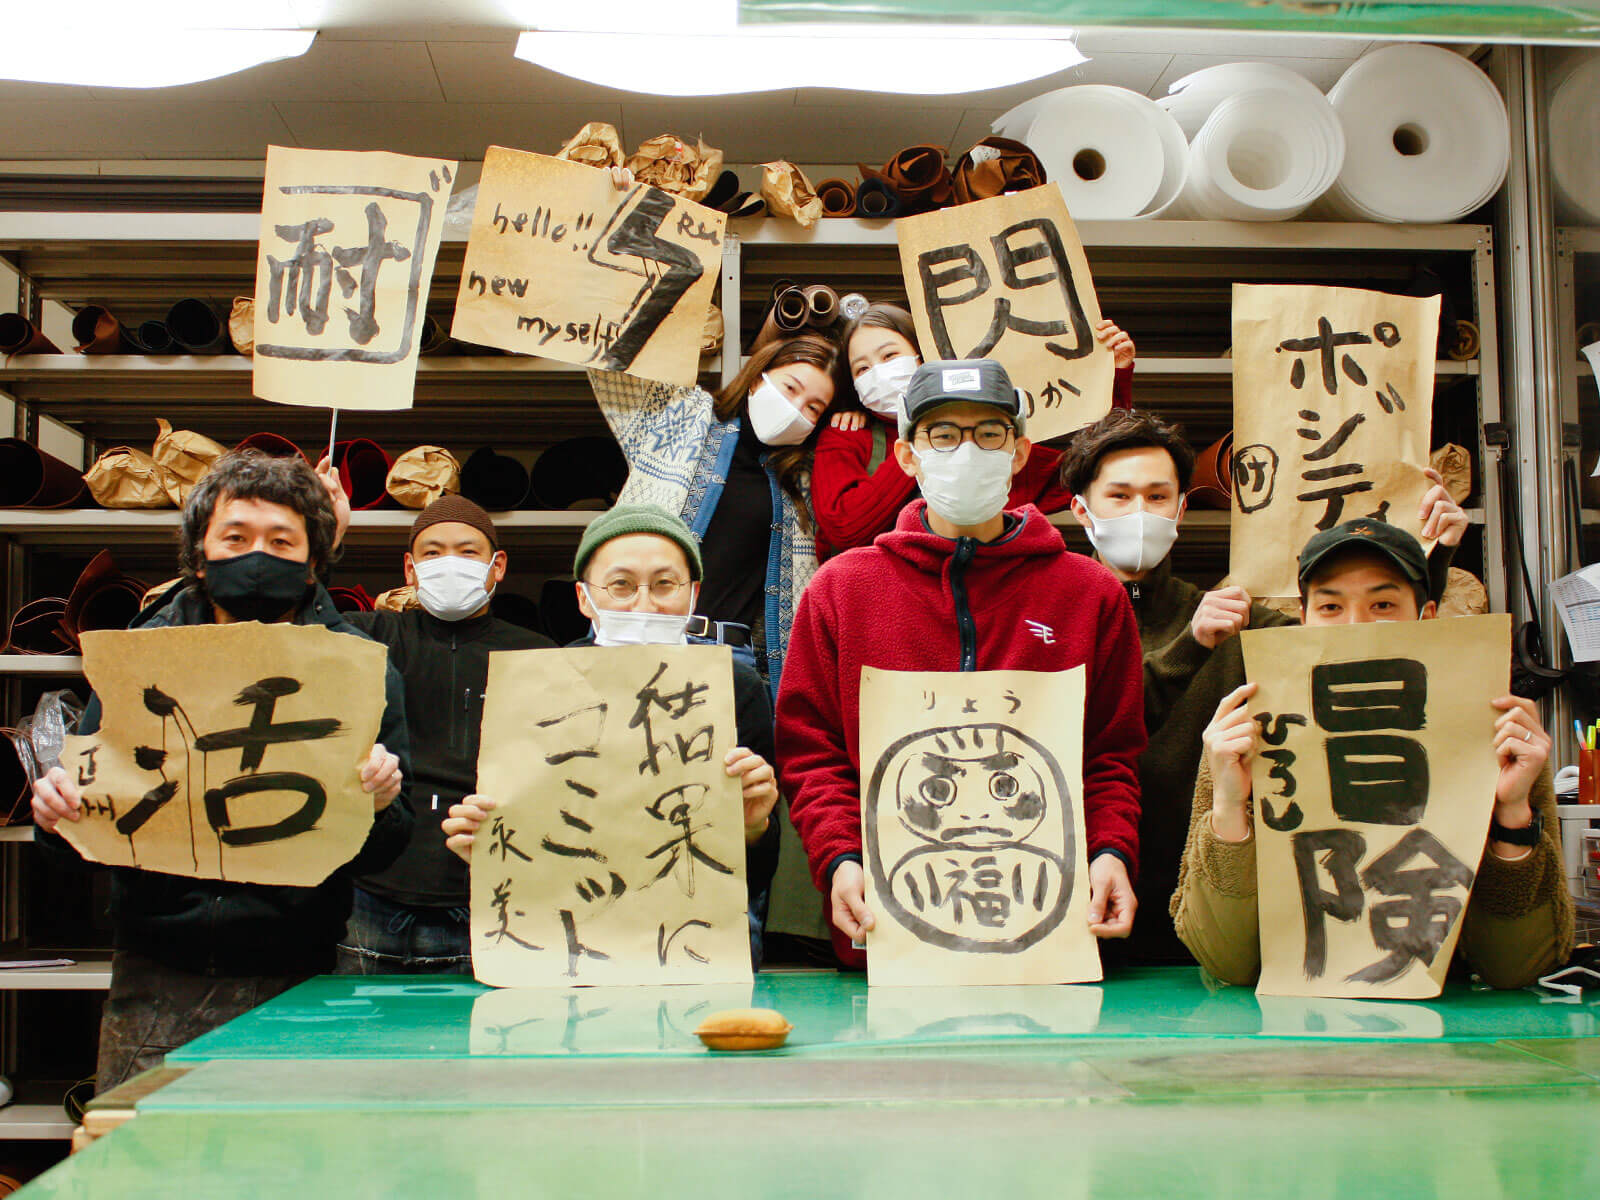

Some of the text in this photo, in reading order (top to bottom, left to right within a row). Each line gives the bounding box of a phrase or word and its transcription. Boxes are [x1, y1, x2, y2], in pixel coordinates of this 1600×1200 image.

[467, 270, 530, 298] new
[492, 202, 593, 252] hello!!
[917, 217, 1094, 361] 閃
[115, 675, 348, 852] 活
[921, 690, 1022, 715] りょう
[628, 662, 735, 968] 結果に
[1253, 711, 1307, 833] ひろし
[1289, 657, 1475, 984] 冒険
[535, 702, 627, 978] コミット
[939, 855, 1012, 929] 福
